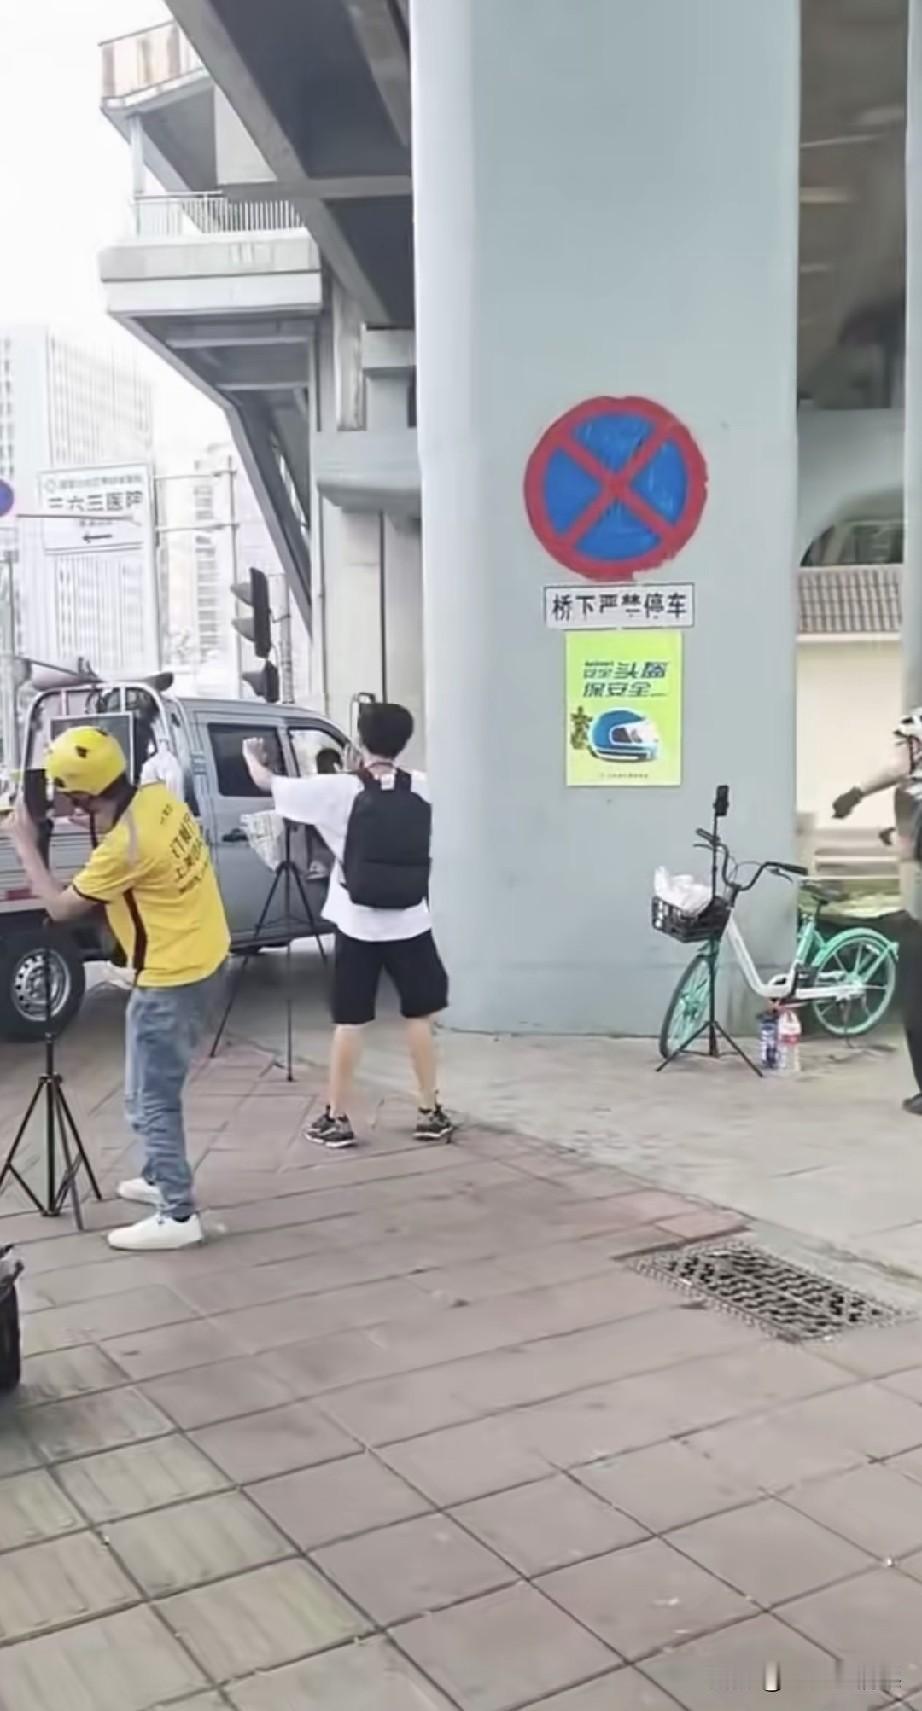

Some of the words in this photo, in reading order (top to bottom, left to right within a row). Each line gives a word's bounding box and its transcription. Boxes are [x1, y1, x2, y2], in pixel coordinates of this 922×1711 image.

[552, 593, 687, 621] 桥下严禁停车
